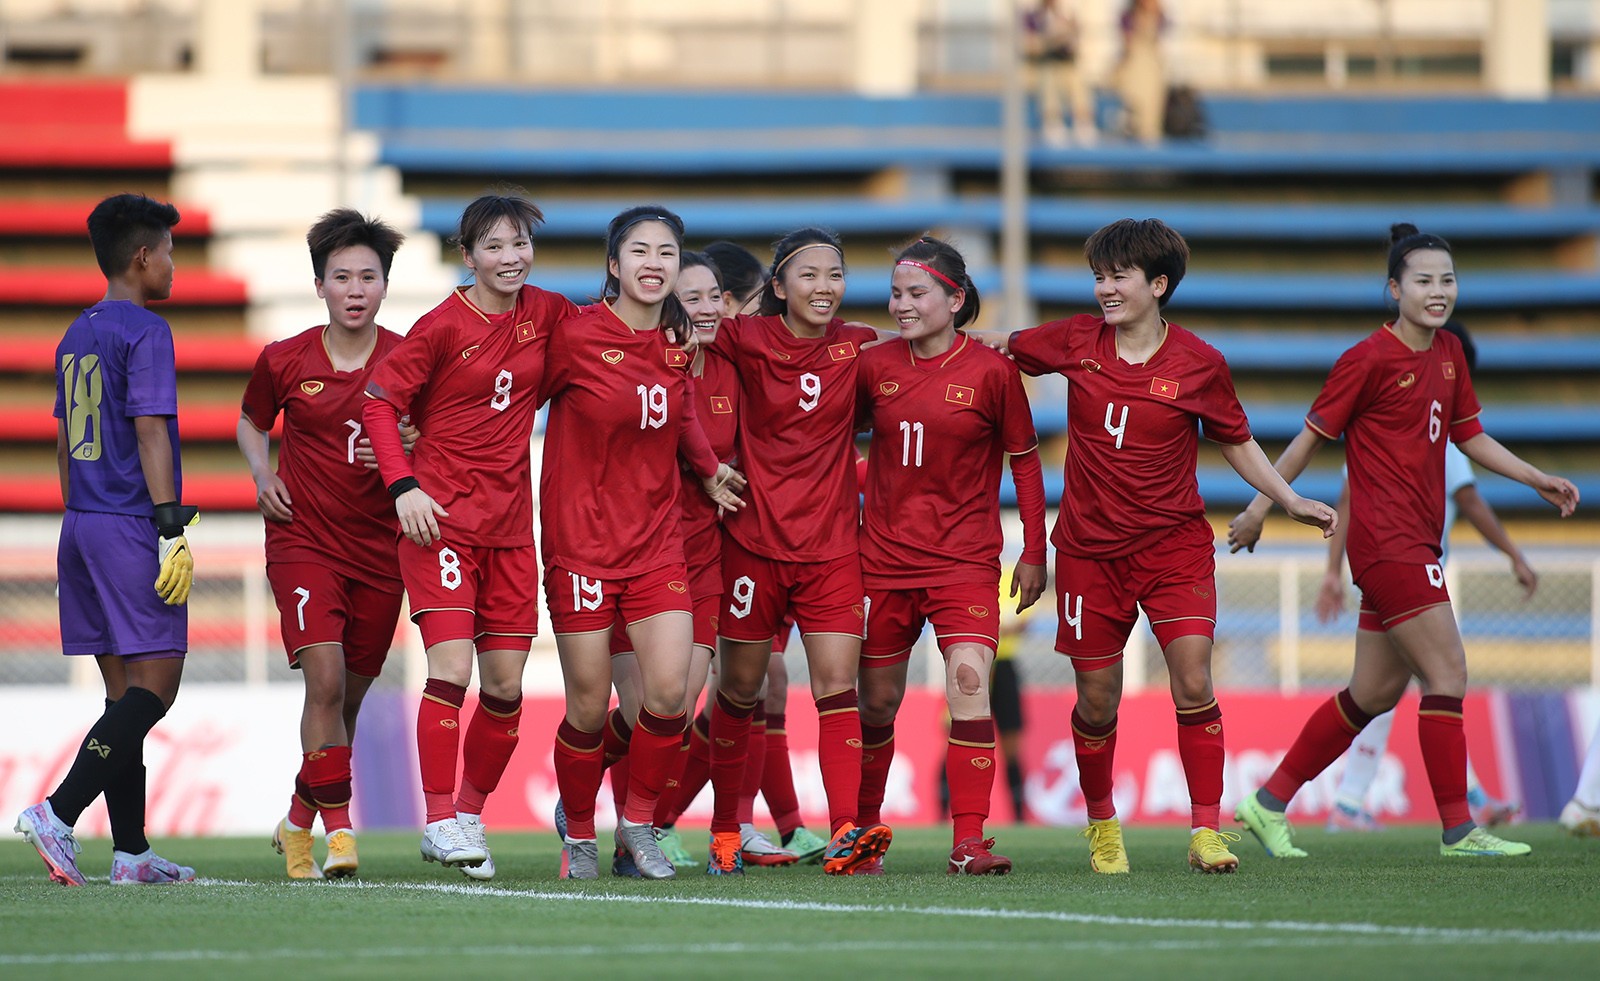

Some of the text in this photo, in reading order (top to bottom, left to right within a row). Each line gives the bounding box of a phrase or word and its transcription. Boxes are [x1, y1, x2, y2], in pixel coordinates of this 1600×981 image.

[62, 354, 102, 461] 18
[491, 370, 513, 412] 8
[637, 384, 667, 429] 19
[798, 373, 821, 412] 9
[343, 419, 361, 463] 7
[1105, 403, 1129, 449] 4
[1430, 400, 1441, 442] 6
[900, 421, 924, 467] 11
[439, 547, 461, 590] 8
[293, 587, 310, 630] 7
[568, 571, 603, 612] 19
[730, 576, 755, 618] 9
[1063, 592, 1082, 640] 4
